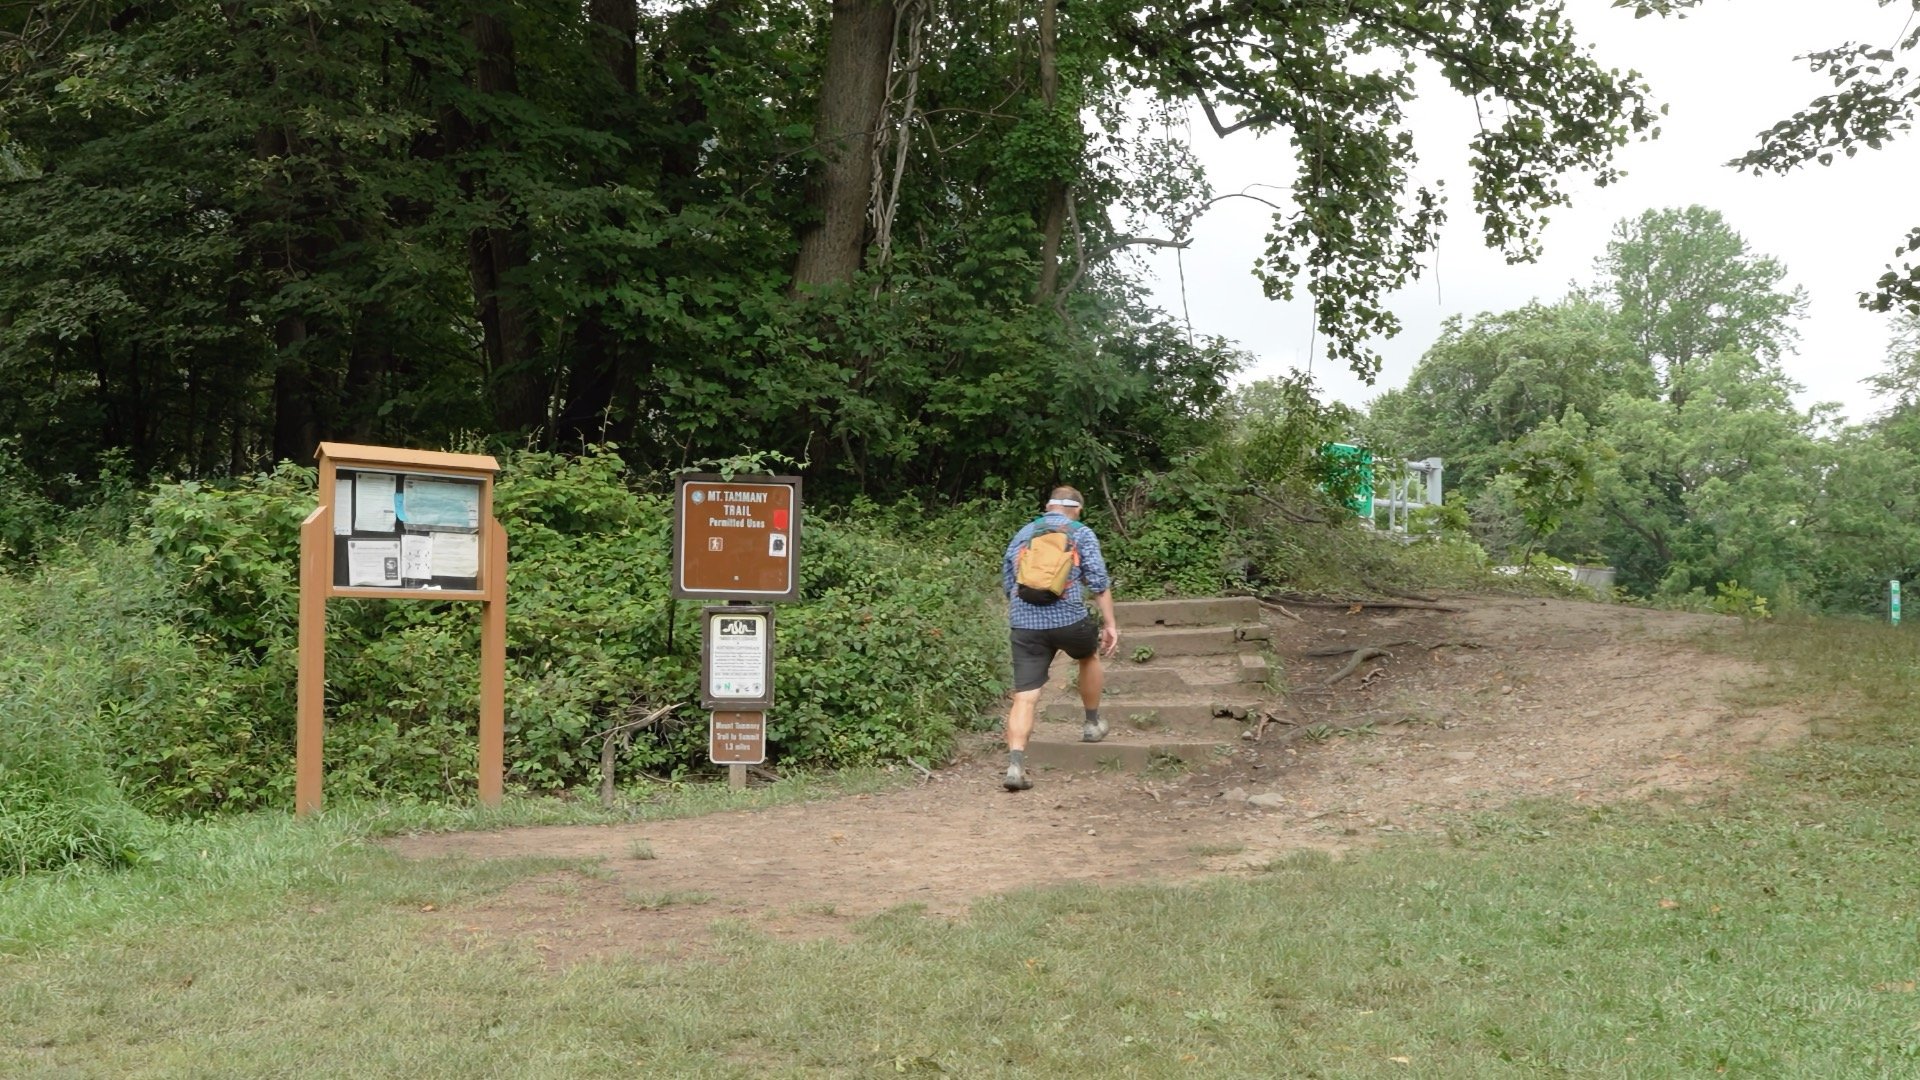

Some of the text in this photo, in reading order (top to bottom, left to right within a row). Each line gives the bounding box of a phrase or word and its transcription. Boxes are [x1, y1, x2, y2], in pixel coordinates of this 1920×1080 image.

[707, 490, 768, 503] MT. TAMMANY
[724, 505, 752, 516] TRAIL
[709, 517, 765, 529] Permitted Uses
[716, 722, 760, 730] Mount Tammany
